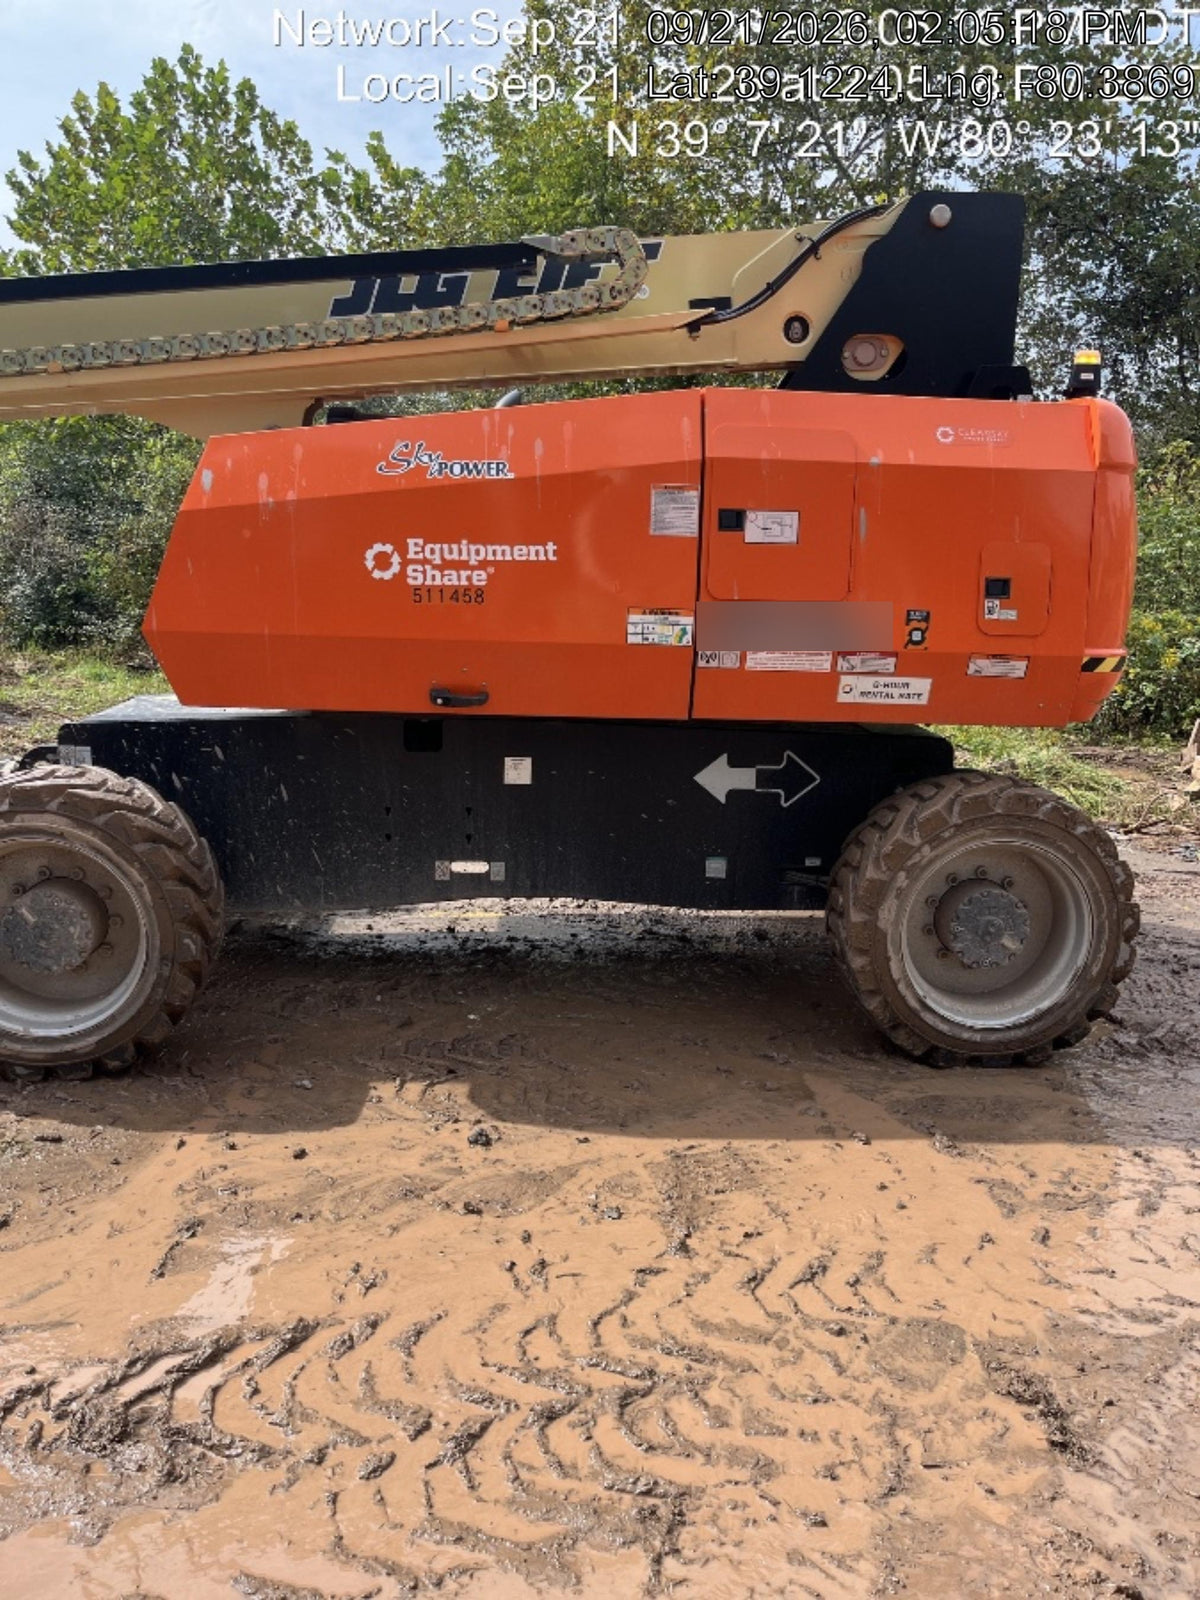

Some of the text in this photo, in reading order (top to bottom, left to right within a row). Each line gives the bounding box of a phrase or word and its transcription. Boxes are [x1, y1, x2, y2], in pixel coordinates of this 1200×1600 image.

[377, 441, 510, 478] Sky POWER
[406, 538, 557, 565] Equipment
[413, 588, 485, 604] 511458
